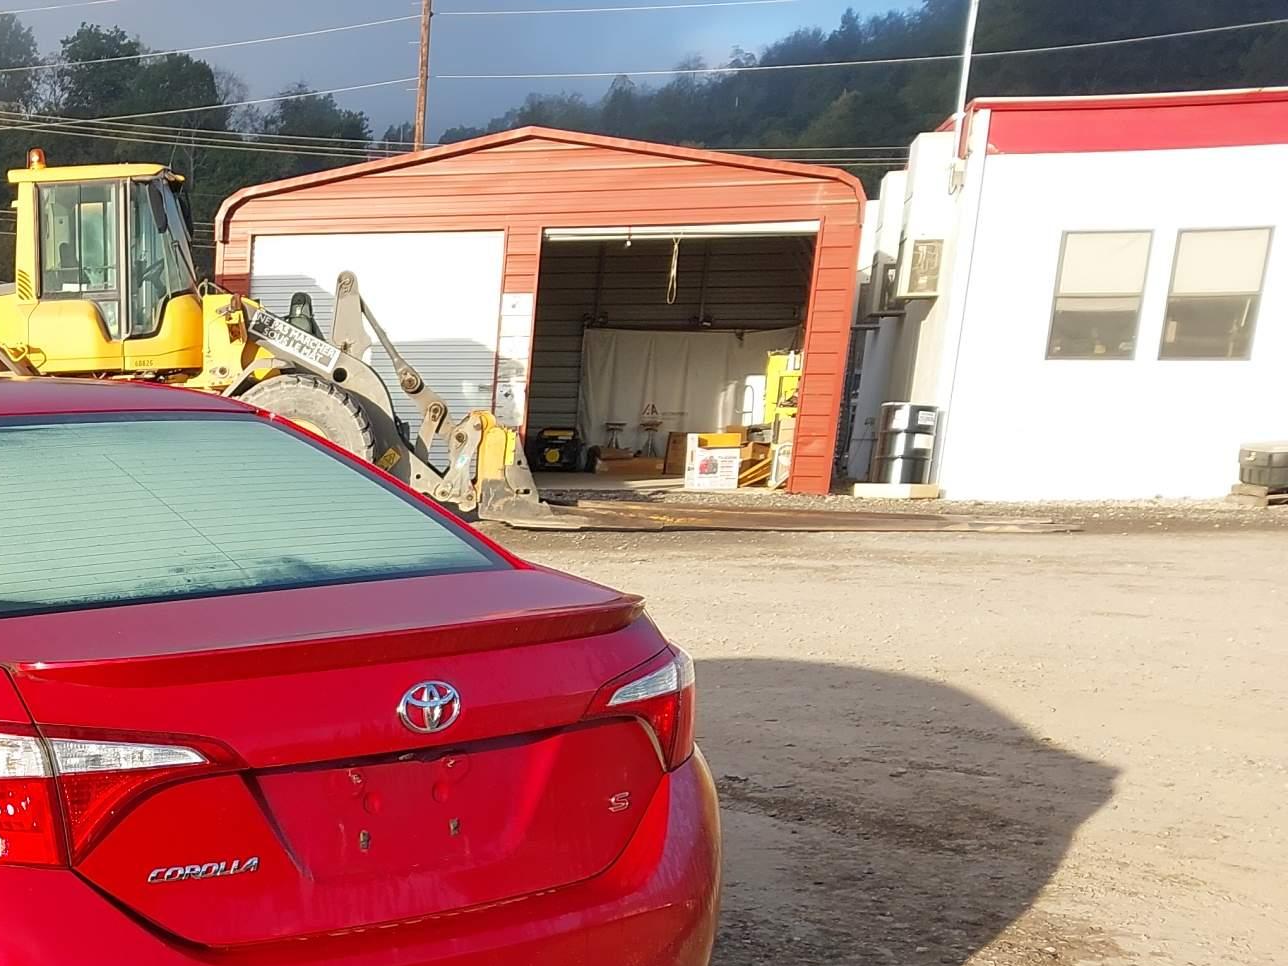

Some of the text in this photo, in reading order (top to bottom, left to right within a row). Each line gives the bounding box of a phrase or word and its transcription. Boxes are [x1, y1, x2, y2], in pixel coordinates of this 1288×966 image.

[255, 312, 336, 359] NE PAS MARCHER
[262, 327, 289, 346] SOUS
[288, 338, 303, 354] LE
[608, 791, 630, 813] S
[147, 857, 259, 882] COROLLA
